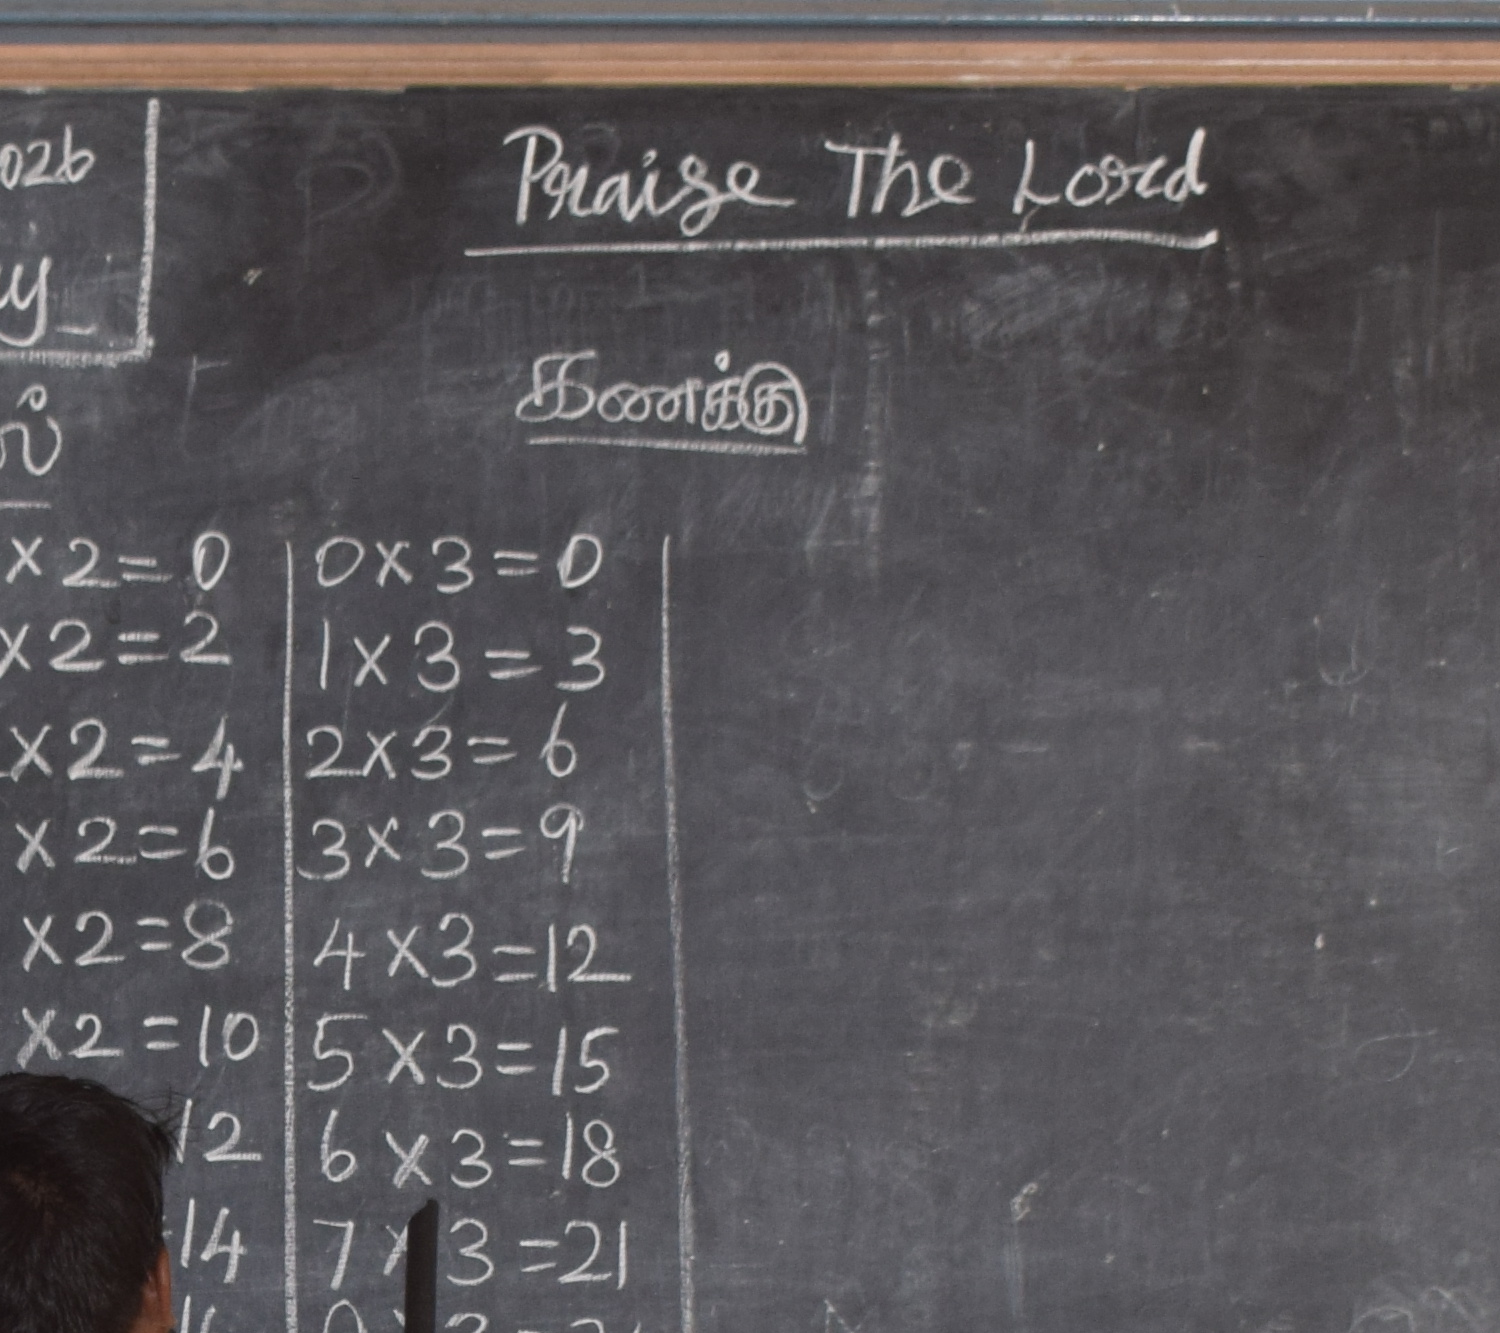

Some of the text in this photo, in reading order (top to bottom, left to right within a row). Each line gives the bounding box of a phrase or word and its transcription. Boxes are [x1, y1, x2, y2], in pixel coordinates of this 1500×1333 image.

[503, 125, 1207, 235] Praise The Lord
[515, 350, 808, 445] கணக்கு
